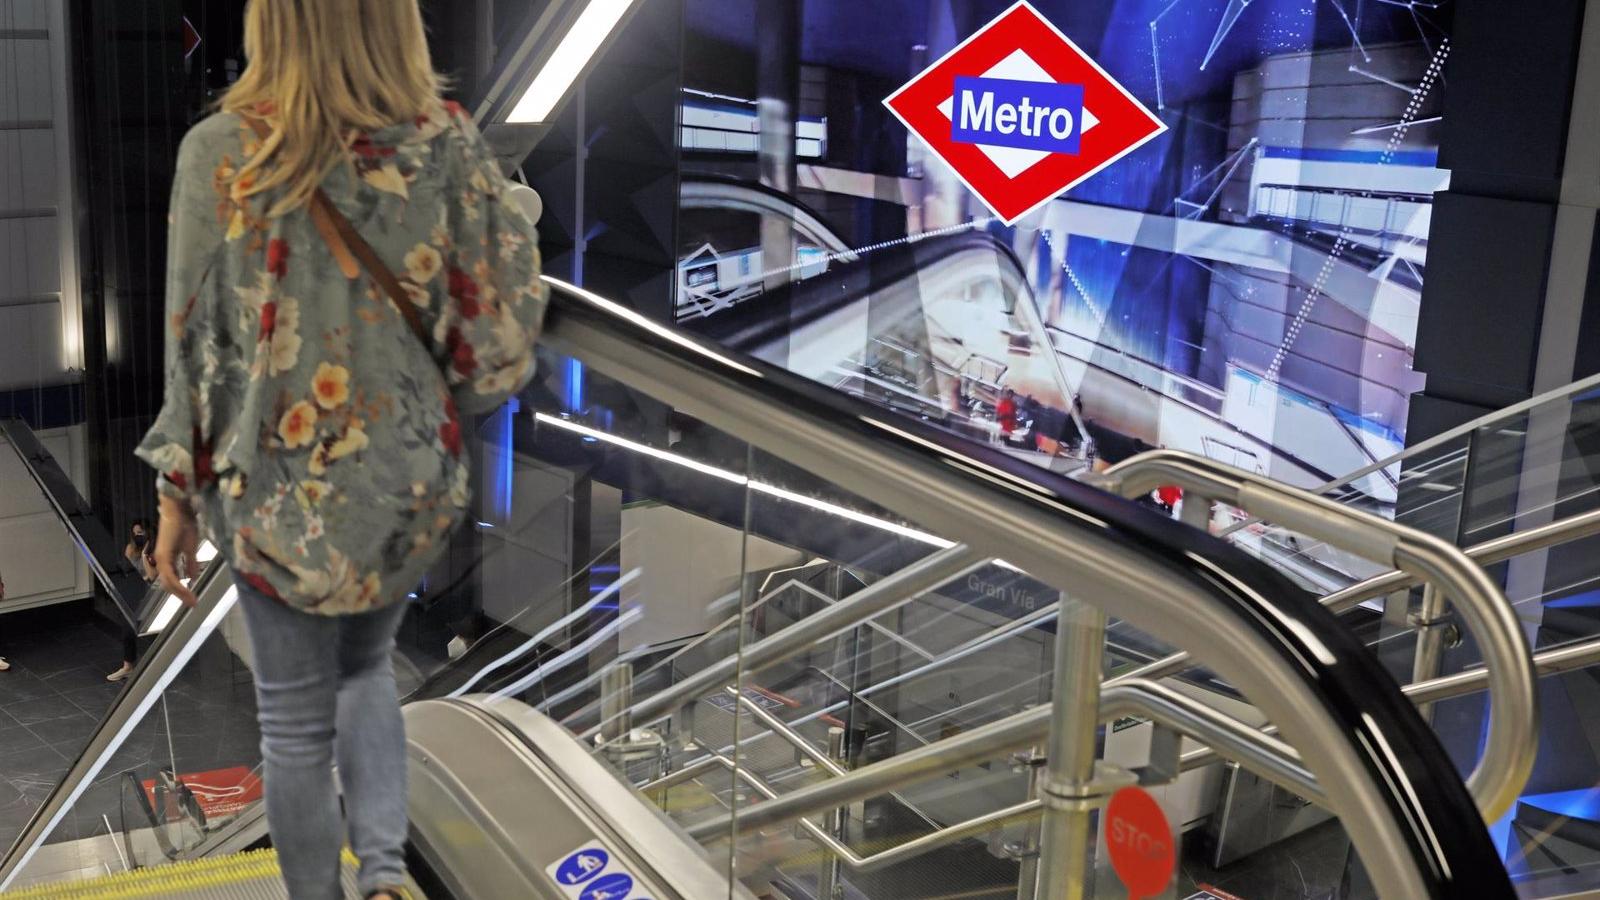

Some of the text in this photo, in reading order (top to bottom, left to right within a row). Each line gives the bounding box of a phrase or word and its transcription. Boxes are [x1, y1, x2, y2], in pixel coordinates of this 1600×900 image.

[960, 89, 1073, 140] Metro
[967, 573, 1035, 609] Gran Vía
